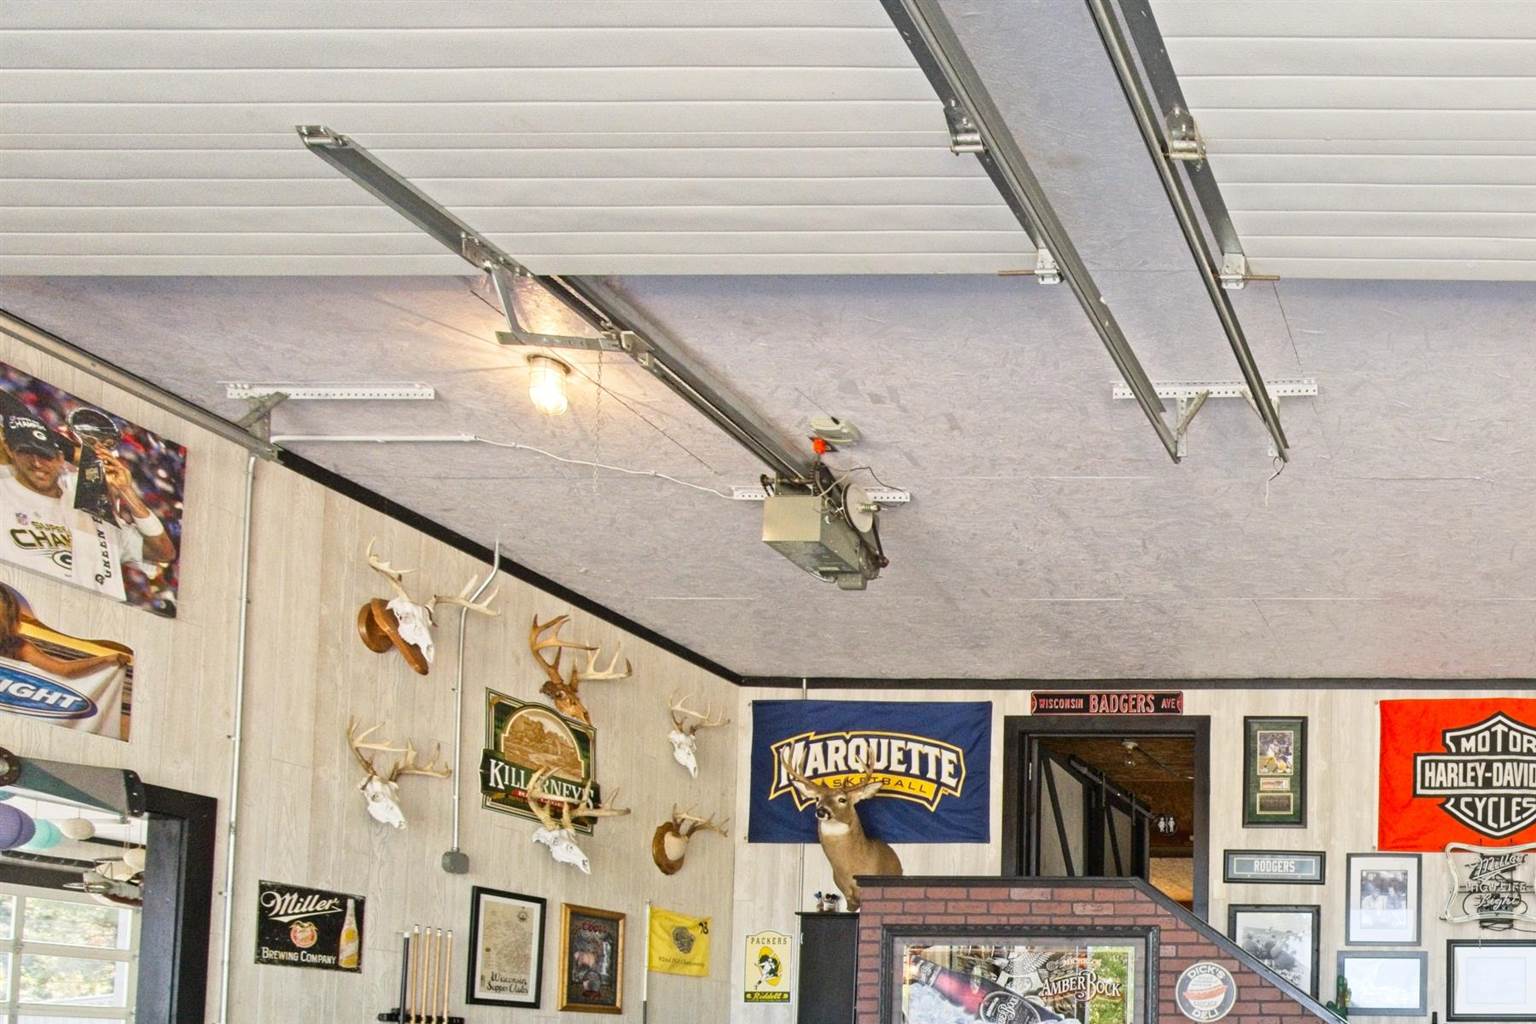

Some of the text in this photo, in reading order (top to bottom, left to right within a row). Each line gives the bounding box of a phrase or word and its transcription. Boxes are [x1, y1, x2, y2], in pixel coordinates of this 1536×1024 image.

[0, 679, 83, 708] IGHT
[1039, 694, 1176, 713] WISCONSIN BADGERS AVE
[1460, 722, 1536, 753] MOTOR
[778, 737, 960, 788] MARQUETTE
[489, 759, 594, 810] KILLRNEYS
[1459, 797, 1536, 829] CYCLES
[1254, 860, 1296, 873] RODGERS
[260, 891, 341, 918] Miller
[750, 937, 787, 945] PACKERS
[262, 947, 337, 965] BREWING COMPANY
[1040, 970, 1122, 1001] AMBER BOCK
[1187, 965, 1226, 979] DICK'S
